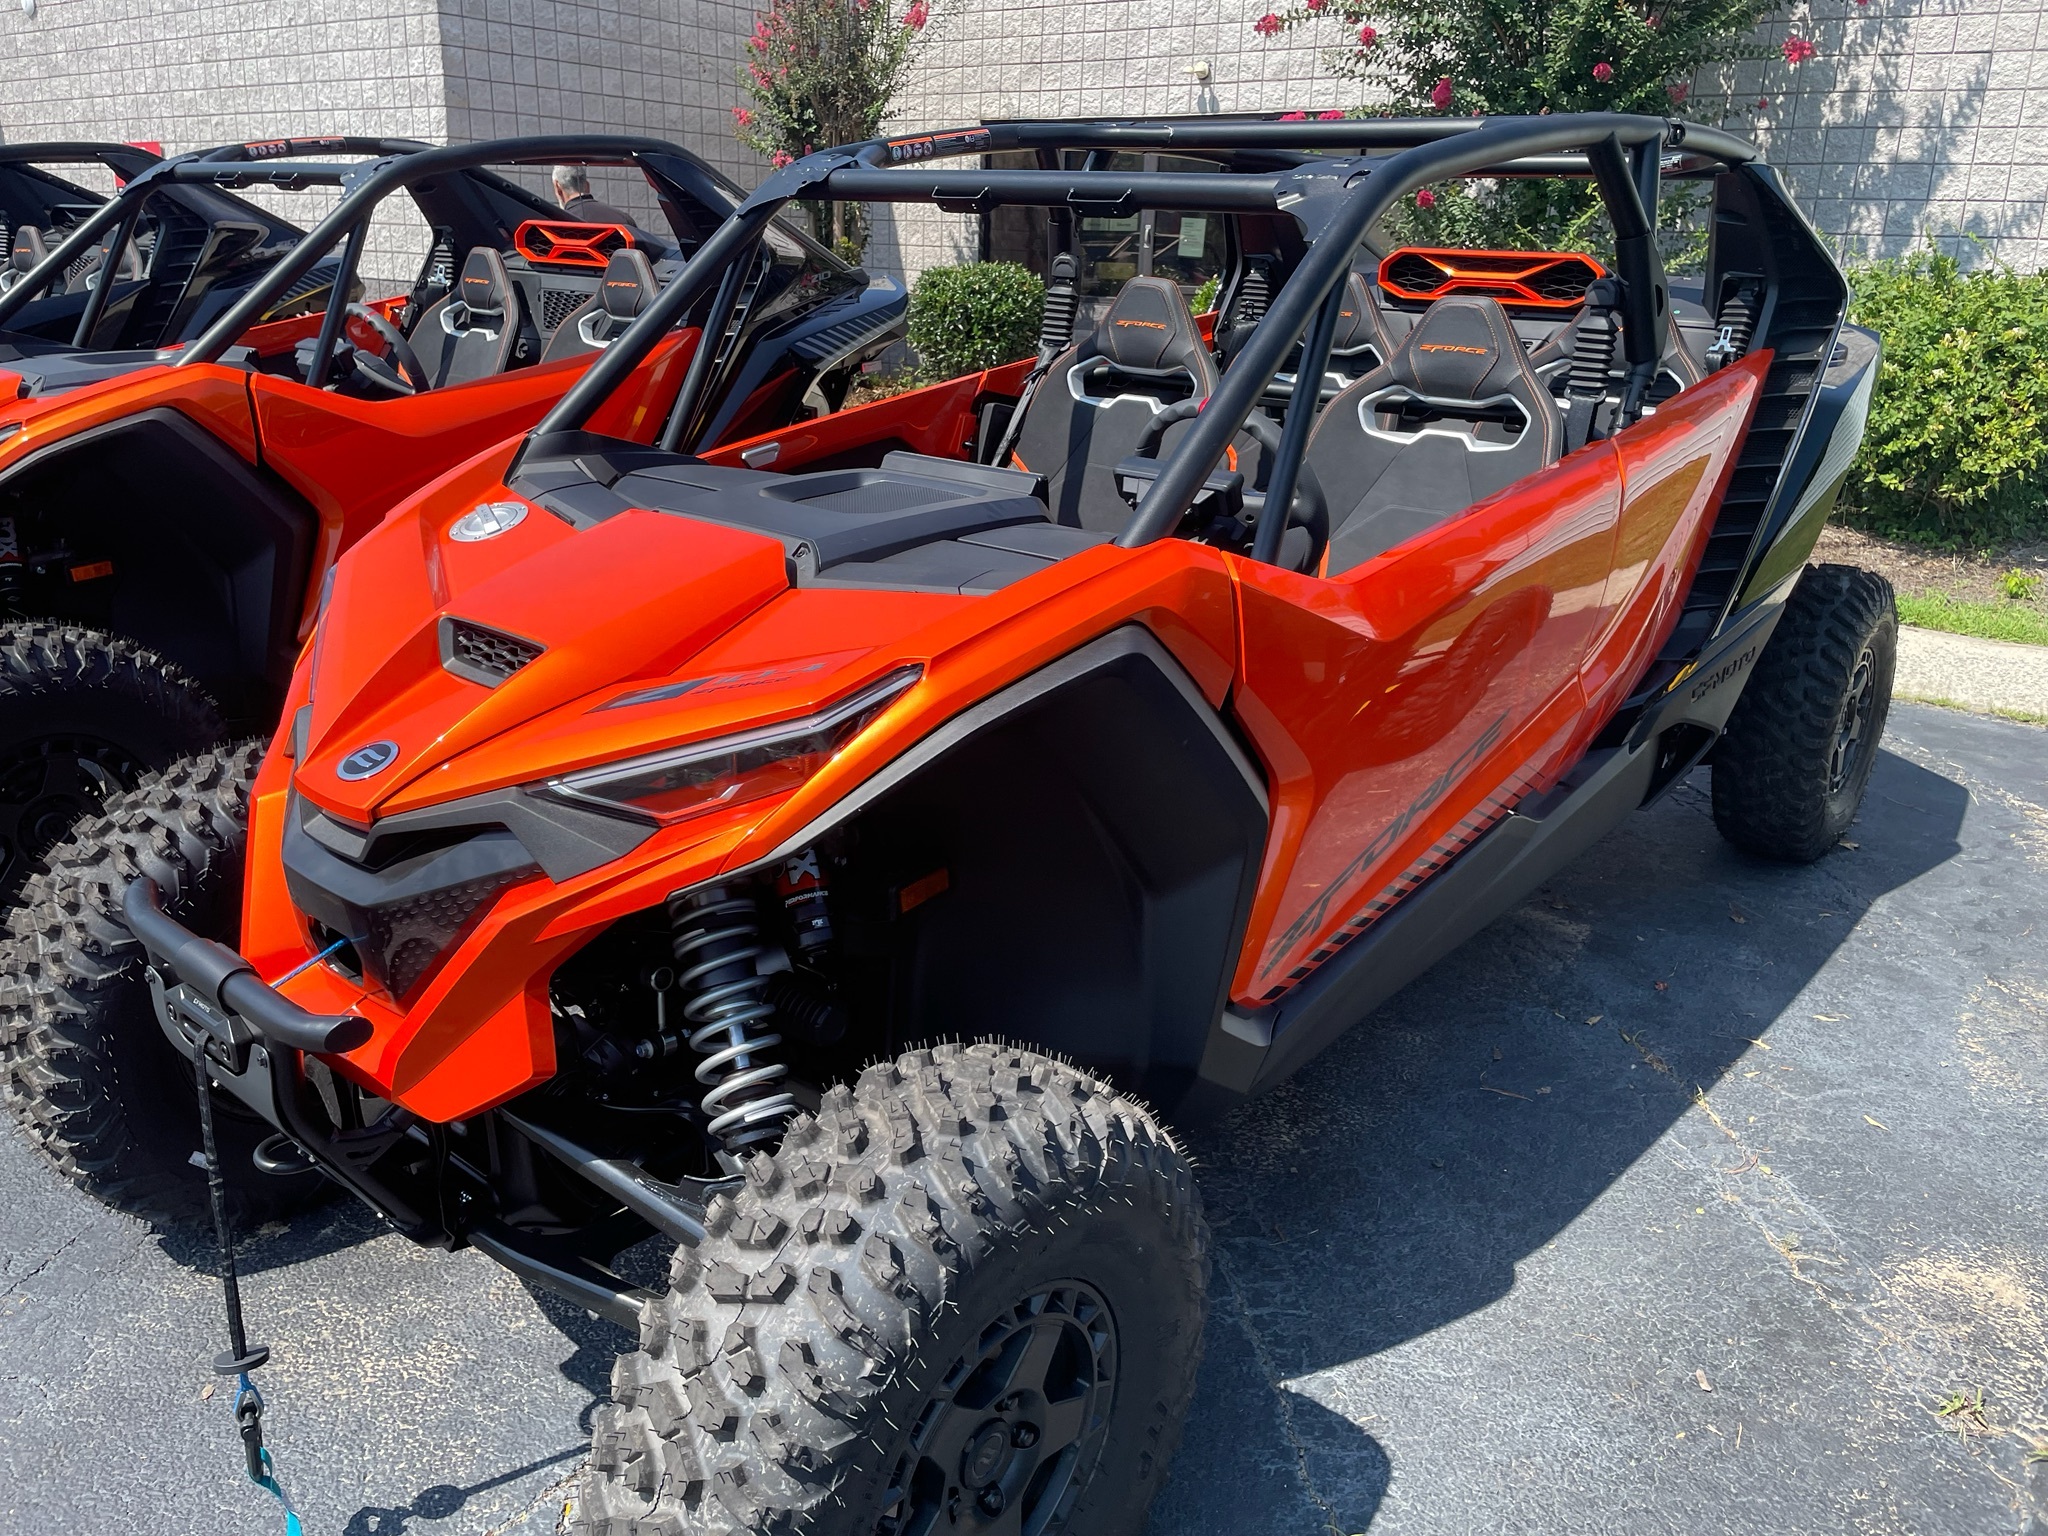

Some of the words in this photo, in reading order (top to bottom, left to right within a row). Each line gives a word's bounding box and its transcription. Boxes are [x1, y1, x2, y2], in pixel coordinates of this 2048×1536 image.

[1116, 319, 1167, 331] ZFORCE
[1420, 343, 1487, 355] ZFORCE
[1690, 646, 1756, 704] CFMOTO
[1260, 707, 1511, 981] ZFORCE
[785, 890, 828, 908] PERFORMANCE
